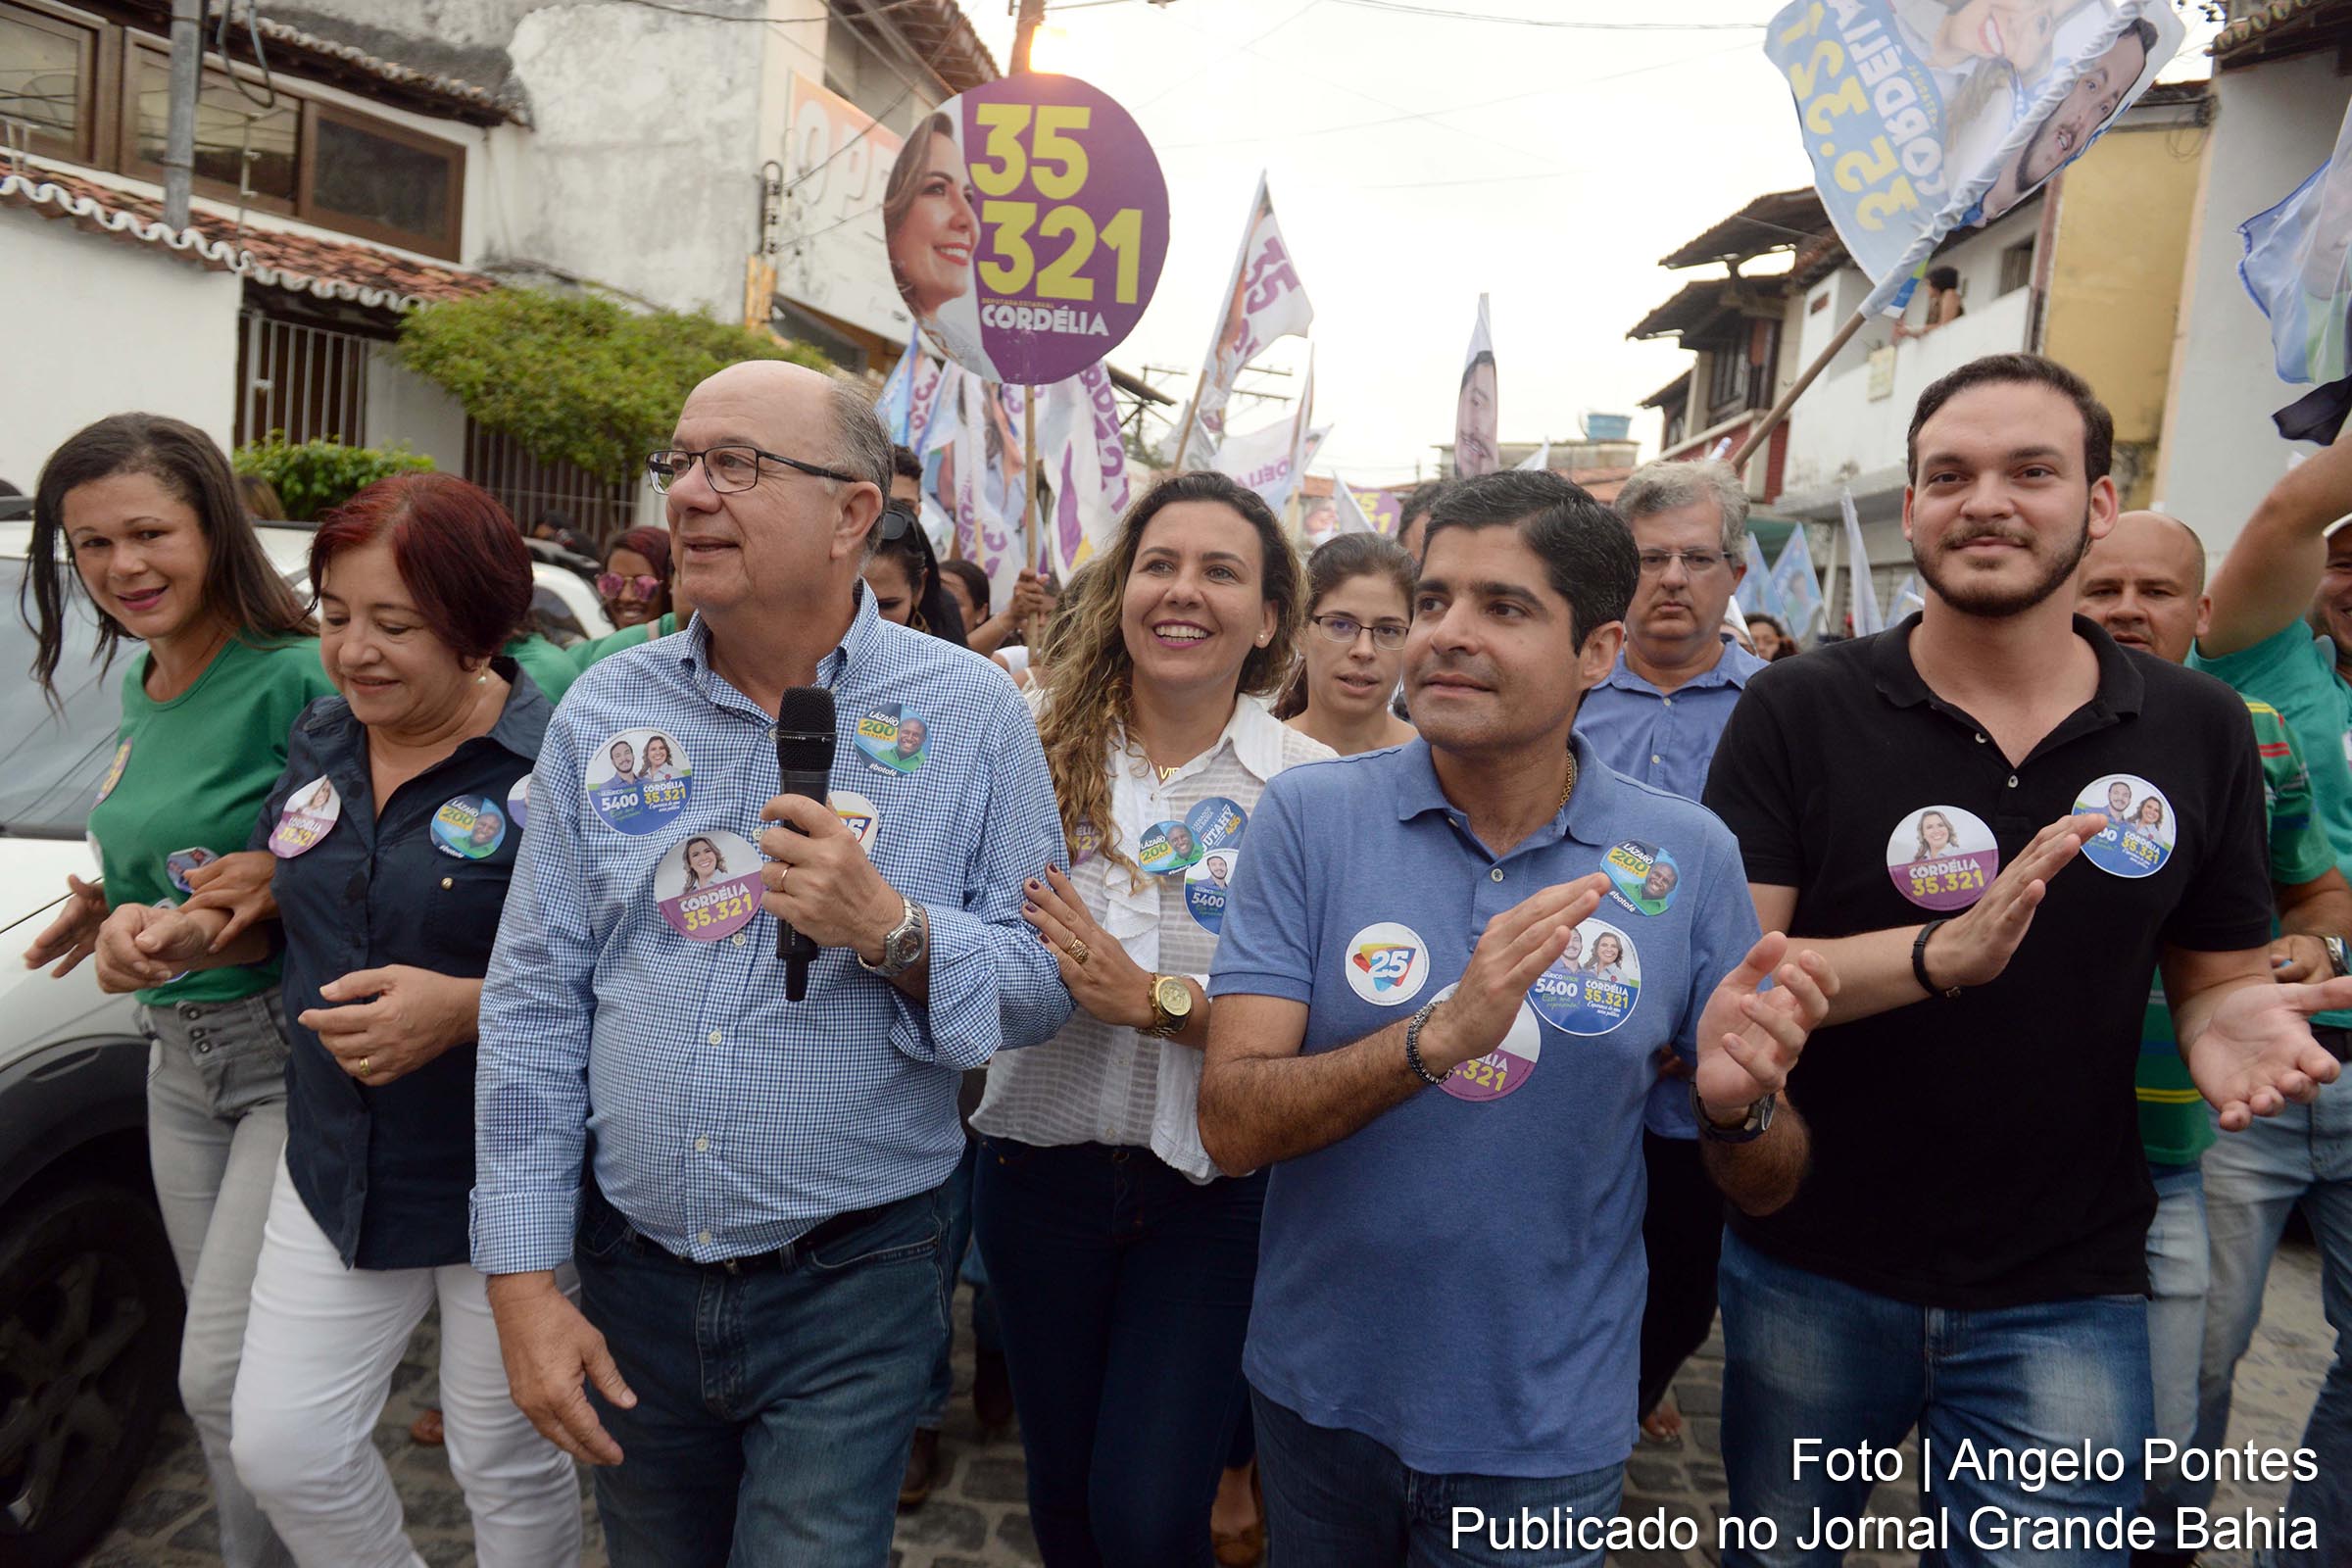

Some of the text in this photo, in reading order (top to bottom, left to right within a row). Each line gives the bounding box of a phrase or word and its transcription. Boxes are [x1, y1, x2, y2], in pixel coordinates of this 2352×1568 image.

[969, 103, 1091, 200] 35
[977, 199, 1143, 305] 321
[981, 305, 1109, 336] CORDÉLIA
[861, 721, 896, 737] 200
[869, 711, 899, 726] LÁZARO
[869, 762, 898, 776] #botofé
[643, 780, 685, 792] CORDÉLIA
[643, 788, 686, 804] 35.321
[602, 794, 639, 811] 5400
[1141, 843, 1169, 861] 200
[1623, 843, 1654, 864] LÁZARO
[2121, 837, 2161, 864] 35.321
[1611, 851, 1647, 872] 200
[1909, 858, 1981, 879] CORDÉLIA
[1911, 869, 1984, 897] 35.321
[680, 882, 750, 912] CORDÉLIA
[1192, 892, 1225, 907] 5400
[683, 893, 753, 931] 35.321
[1372, 951, 1409, 978] 25
[1535, 978, 1578, 998] 5400
[1584, 988, 1629, 1009] 35.321
[1586, 980, 1629, 997] CORDÉLIA
